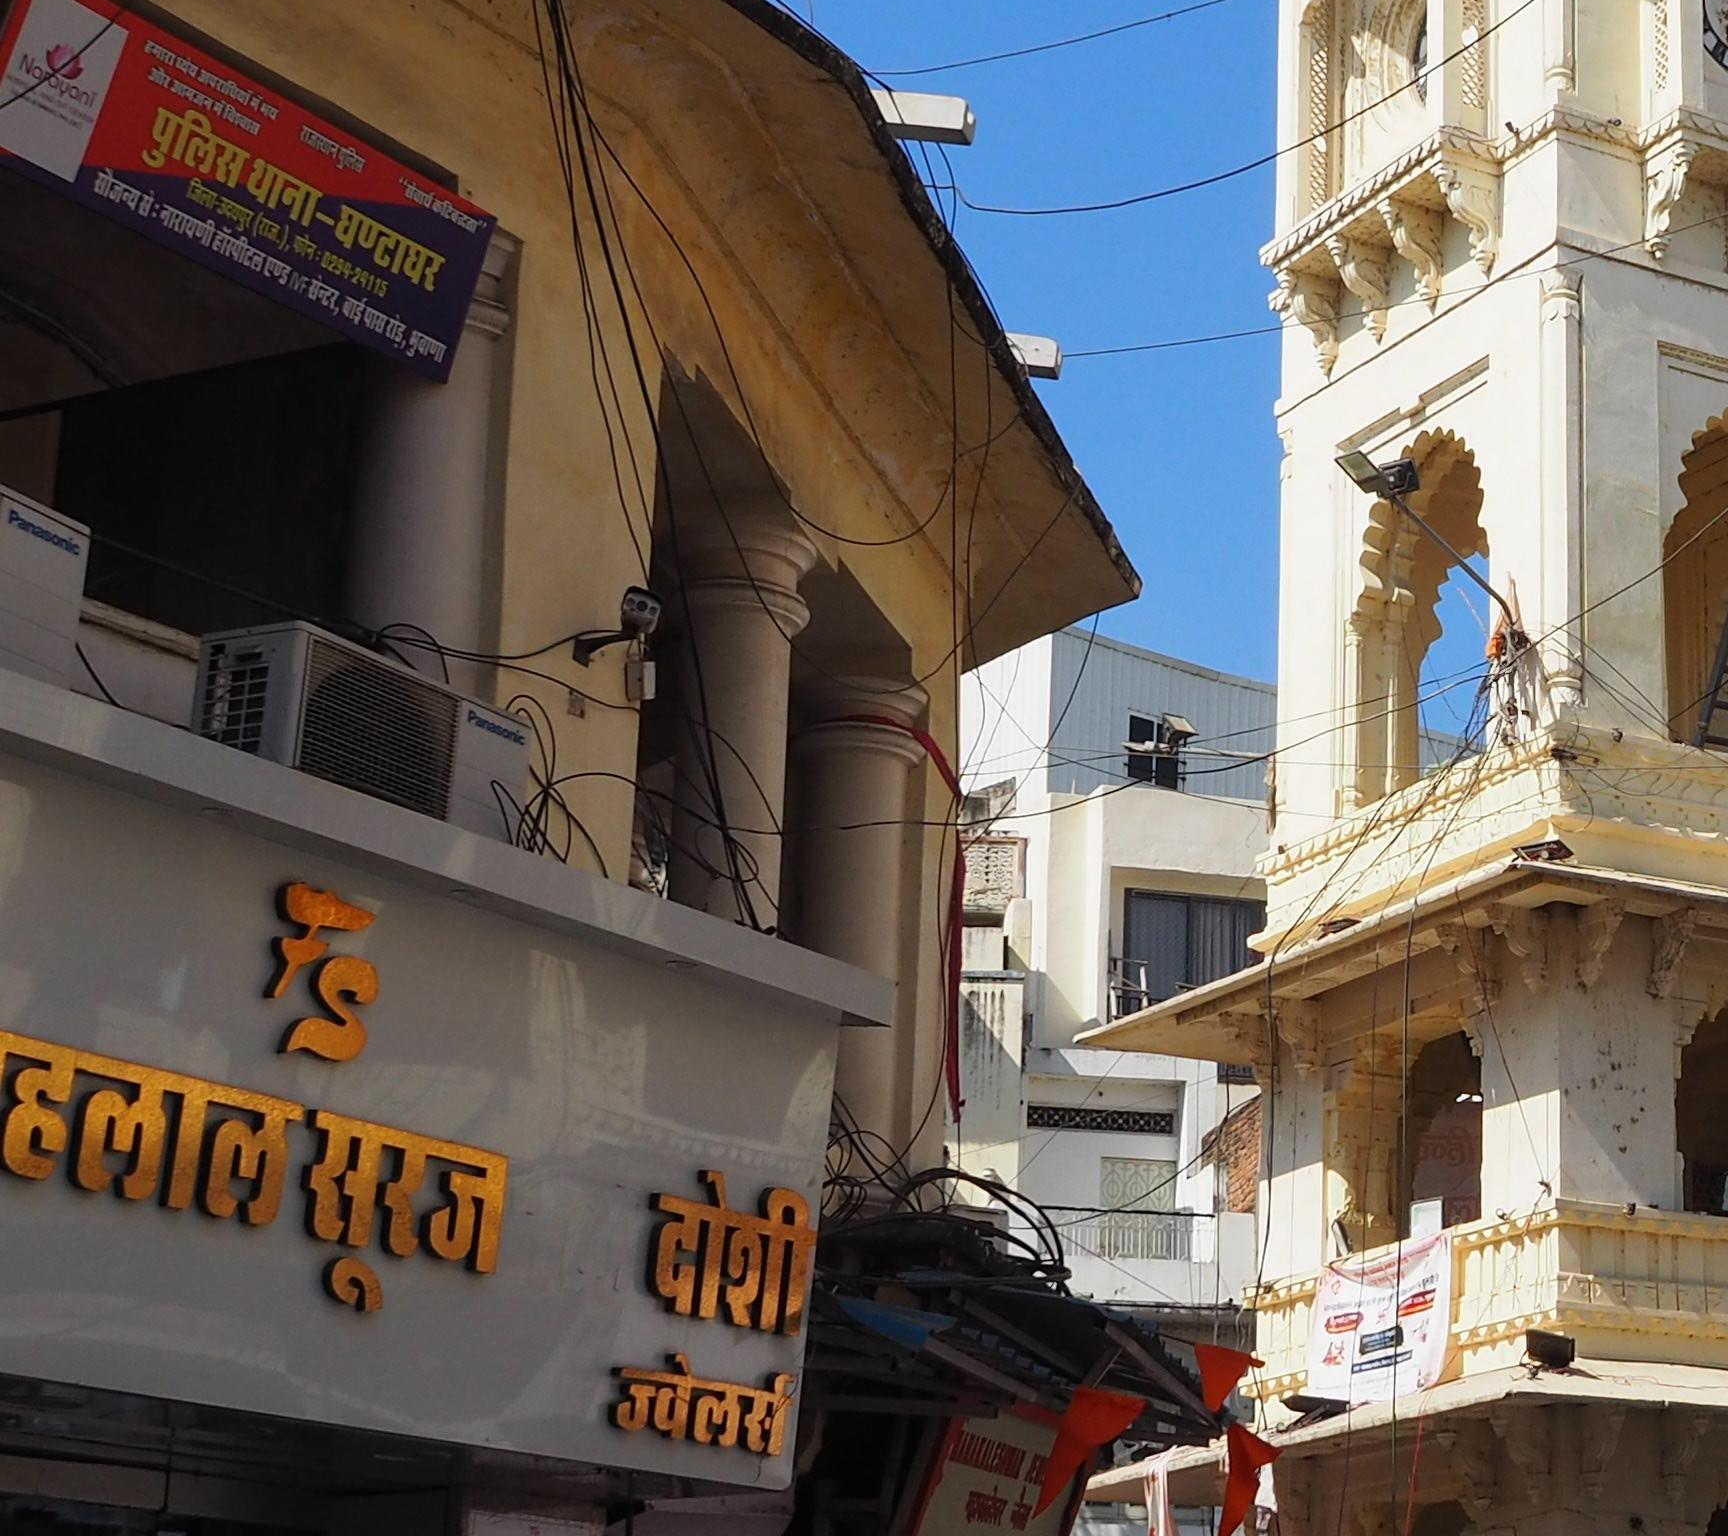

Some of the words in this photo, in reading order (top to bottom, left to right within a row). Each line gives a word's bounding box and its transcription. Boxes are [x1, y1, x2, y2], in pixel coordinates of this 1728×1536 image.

[142, 107, 249, 188] पुलिस
[8, 509, 80, 556] Panasonic
[467, 710, 525, 746] Panasonic
[308, 1108, 510, 1312] सूरज
[653, 1169, 819, 1336] दोशी
[613, 1352, 796, 1456] ज्वेलर्स
